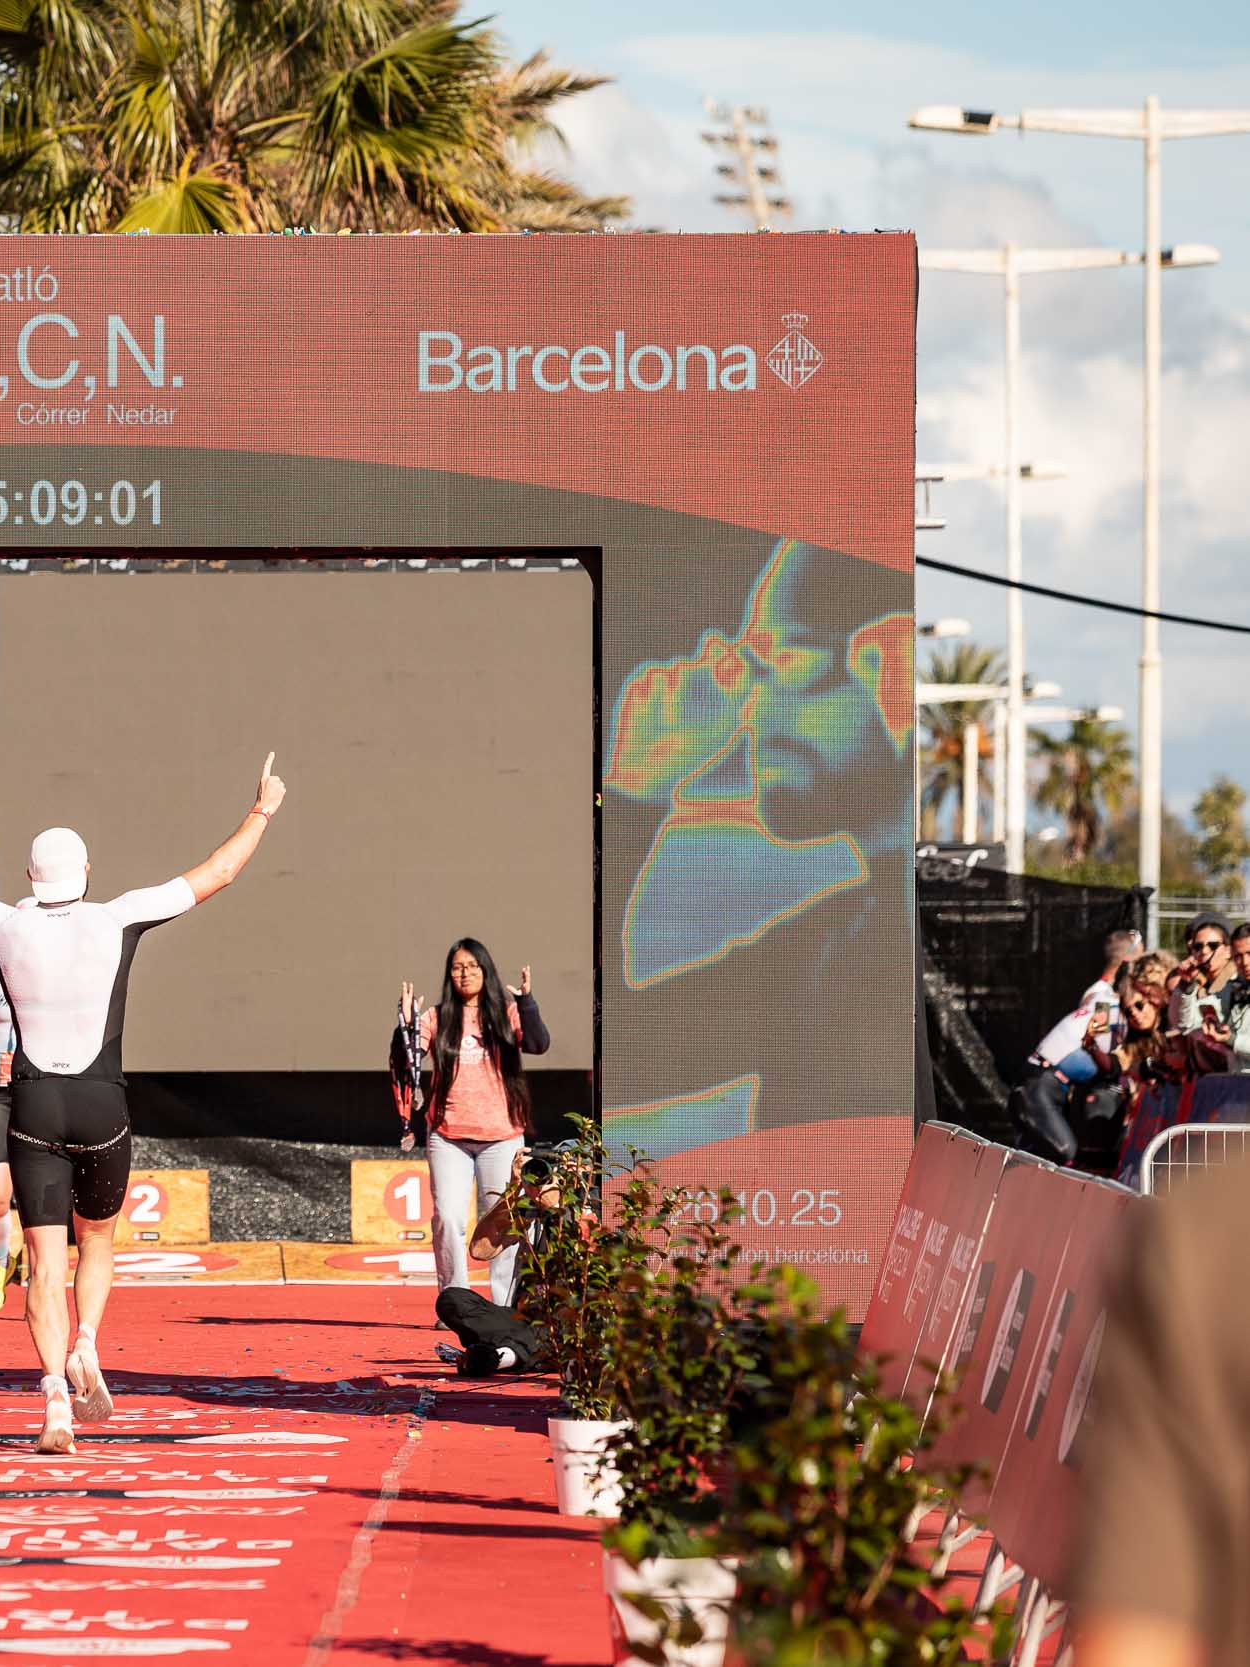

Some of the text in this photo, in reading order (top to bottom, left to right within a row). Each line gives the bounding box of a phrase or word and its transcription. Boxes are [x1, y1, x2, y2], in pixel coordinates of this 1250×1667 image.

[416, 330, 757, 393] Barcelona
[105, 403, 178, 426] Nedar
[129, 1185, 161, 1223] 2
[394, 1176, 422, 1221] 1
[669, 1188, 843, 1227] 2610.25
